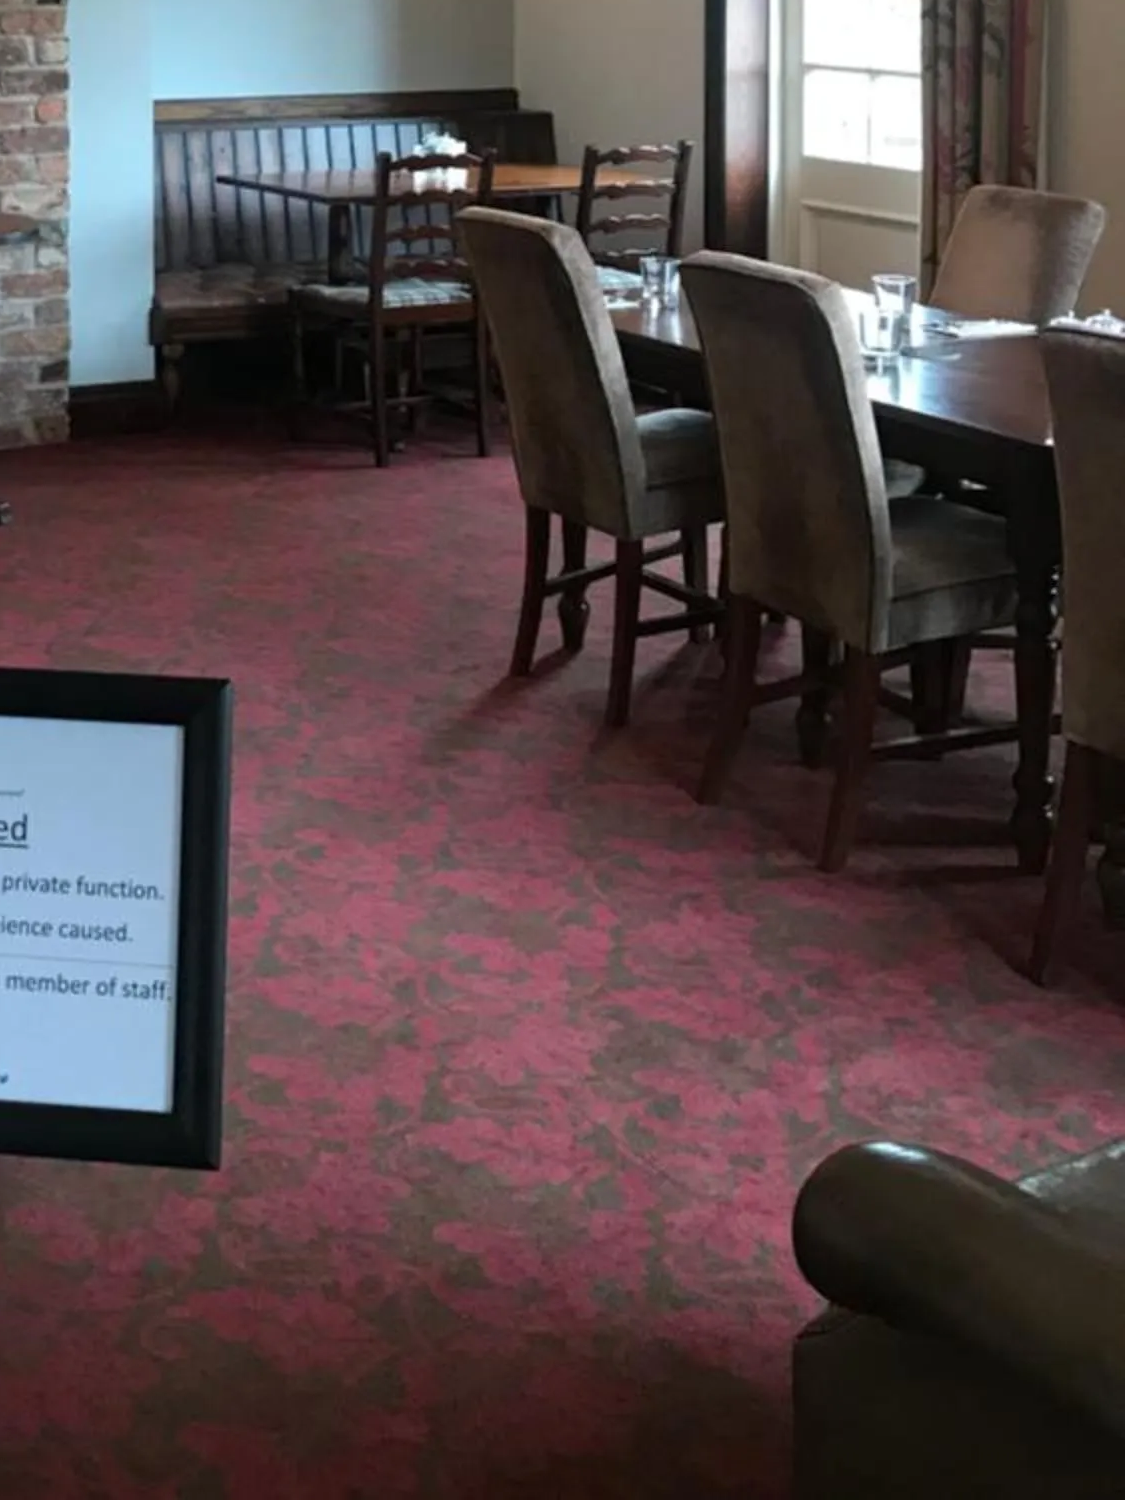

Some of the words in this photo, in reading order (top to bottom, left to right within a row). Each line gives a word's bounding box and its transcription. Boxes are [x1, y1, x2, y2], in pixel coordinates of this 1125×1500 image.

[1, 875, 71, 897] private
[76, 877, 164, 900] function.
[58, 924, 133, 942] caused.
[5, 973, 90, 996] member
[95, 978, 118, 997] of
[122, 980, 172, 1001] staff.
